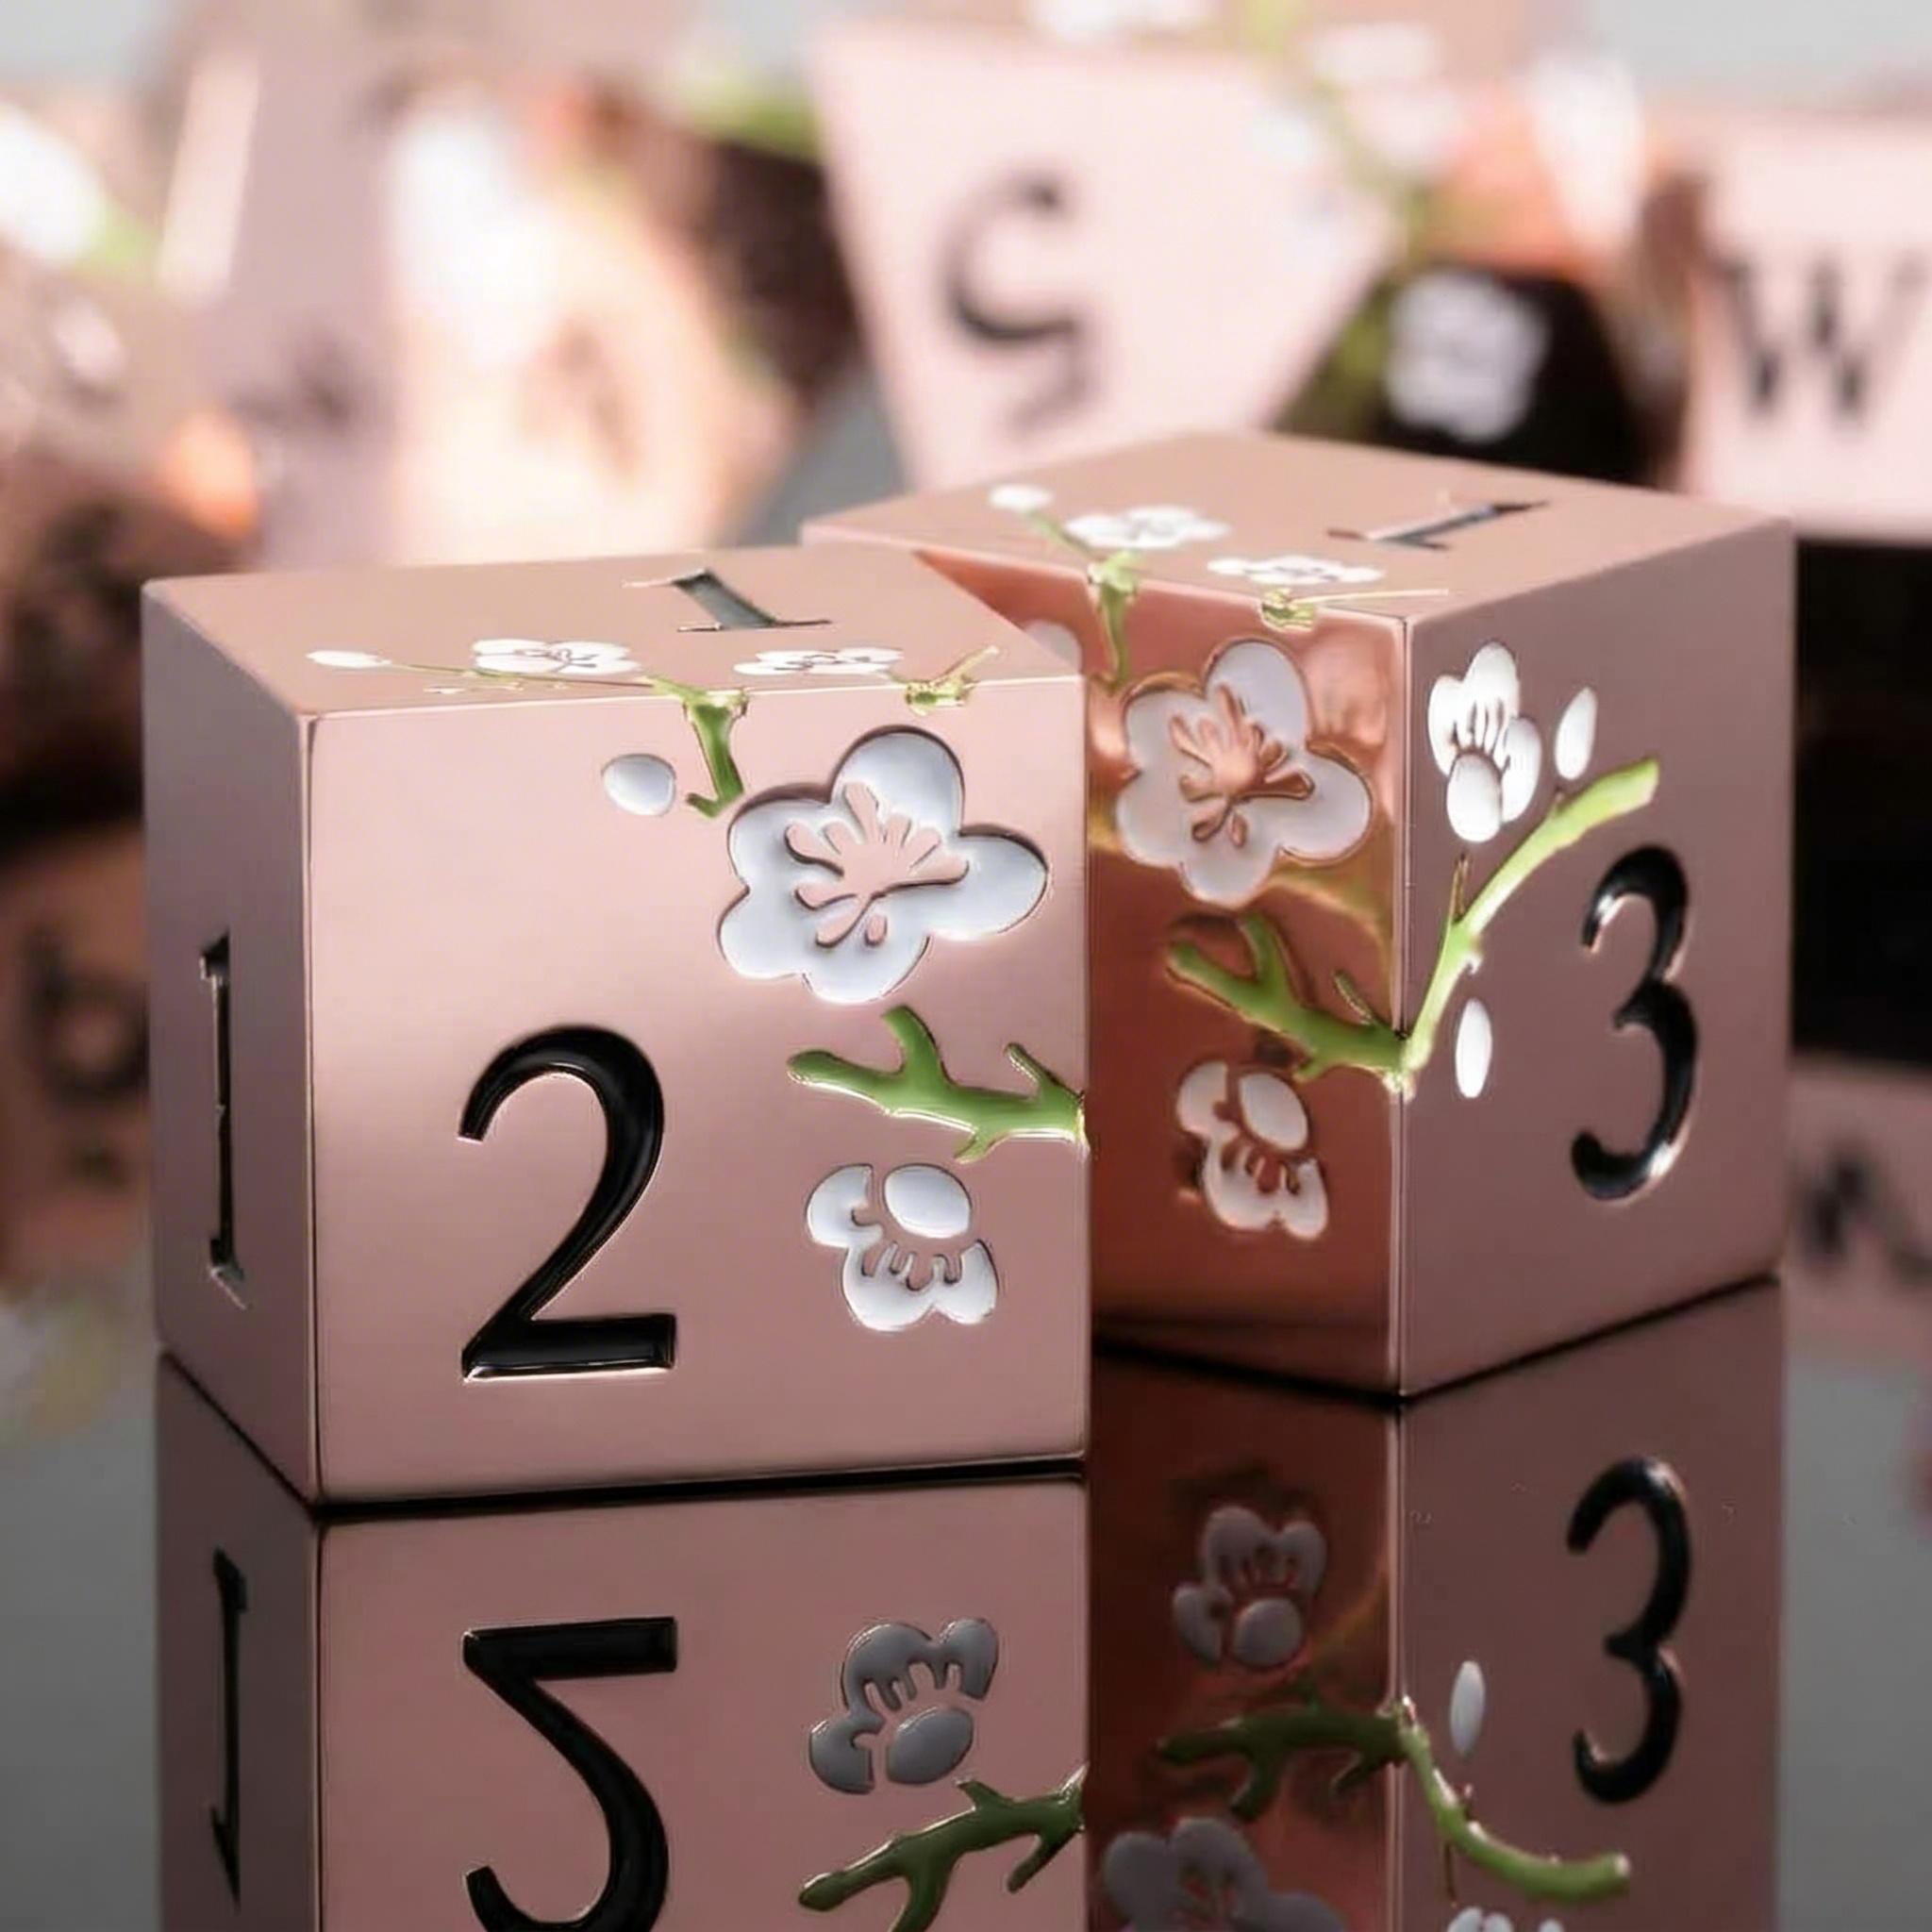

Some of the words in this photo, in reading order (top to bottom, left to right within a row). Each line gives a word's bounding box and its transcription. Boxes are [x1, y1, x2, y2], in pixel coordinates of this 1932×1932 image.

[623, 567, 834, 633] 1
[1325, 497, 1550, 551] 1
[199, 929, 249, 1310] 1
[1570, 843, 1700, 1204] 3
[458, 1024, 678, 1384] 2
